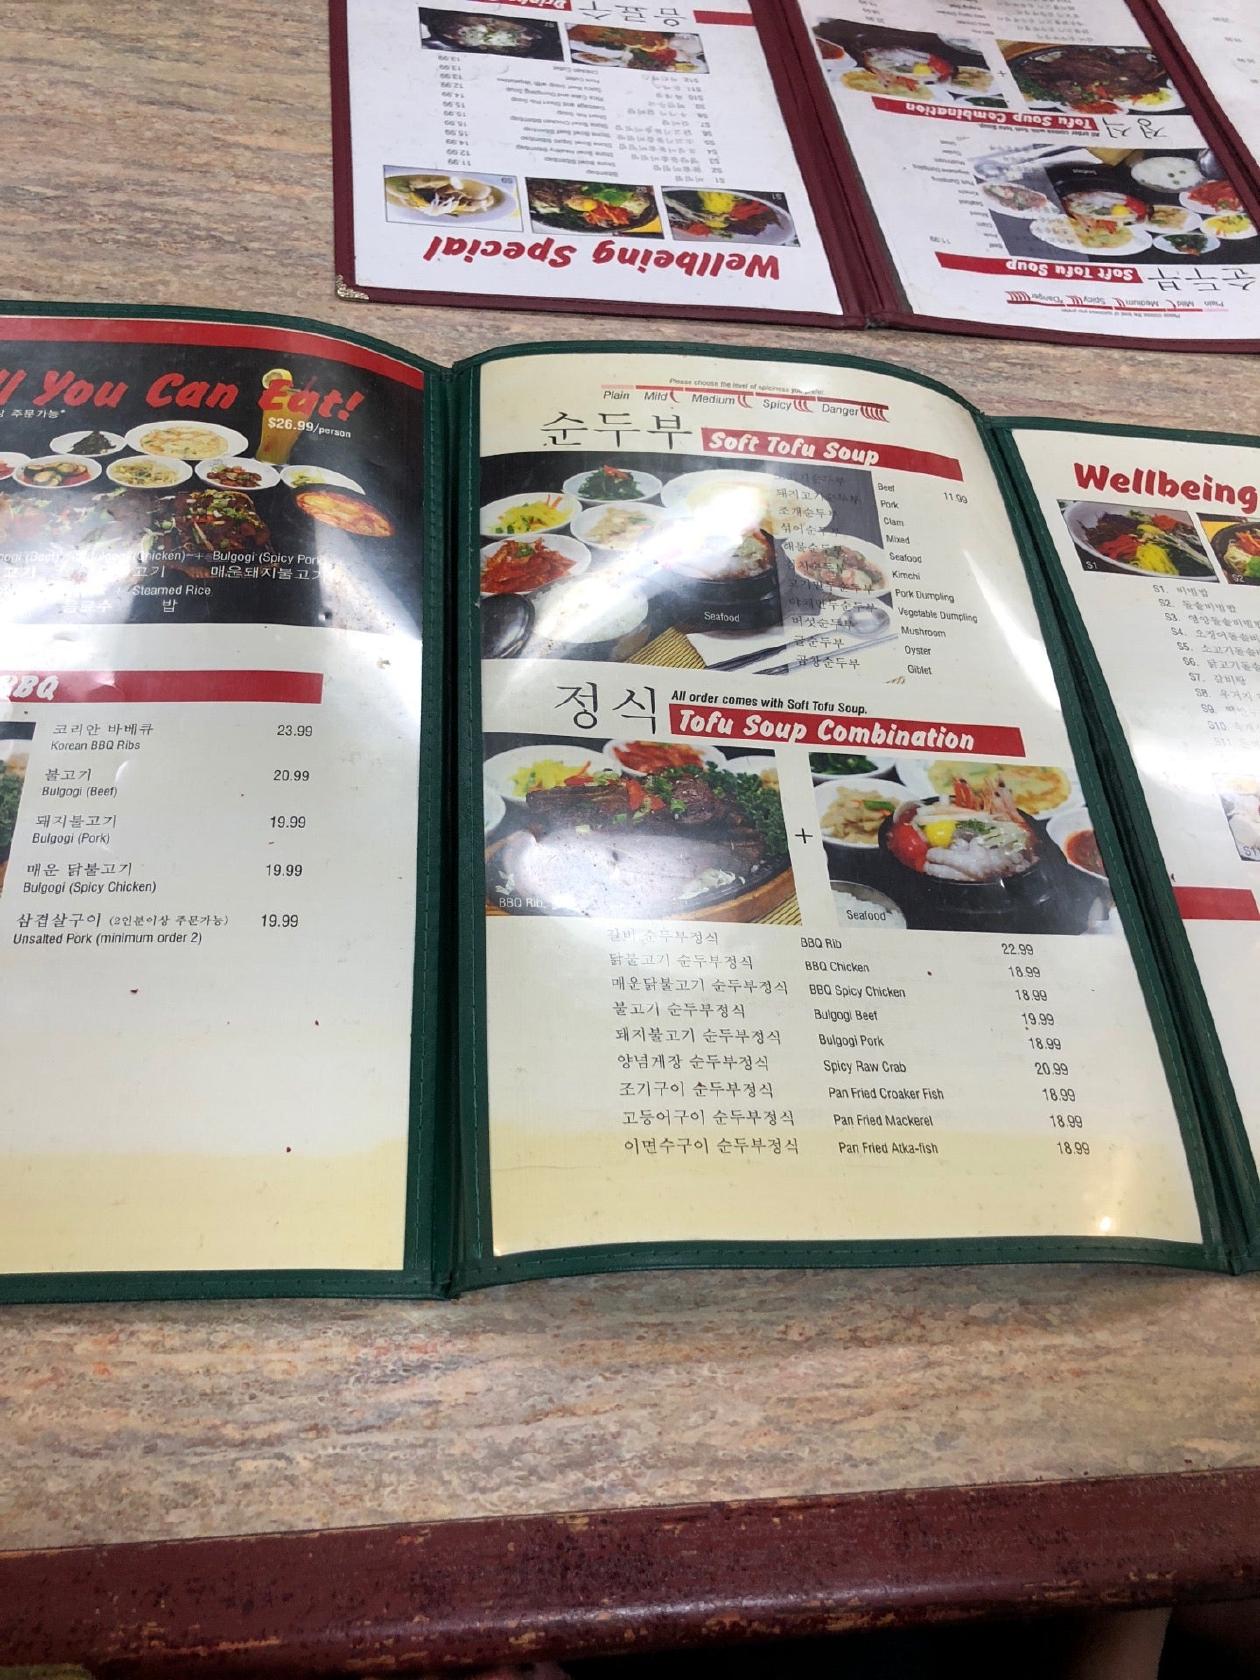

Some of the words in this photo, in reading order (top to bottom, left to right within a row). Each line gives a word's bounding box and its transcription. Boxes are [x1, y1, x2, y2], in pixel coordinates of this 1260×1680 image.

[905, 102, 1007, 124] Combination
[1014, 113, 1052, 127] Soup
[1058, 116, 1092, 129] Tofu
[423, 235, 577, 268] Special
[592, 240, 781, 280] Wellbeing
[1005, 260, 1048, 275] Soup
[1055, 266, 1093, 279] Tofu
[1098, 269, 1133, 281] Soft
[33, 370, 128, 408] You
[146, 373, 239, 409] Can
[258, 379, 365, 421] Eat!
[603, 390, 629, 400] Plain
[644, 391, 667, 401] Mild
[692, 393, 735, 405] Medium
[763, 398, 792, 411] Spicy
[822, 403, 858, 417] Danger
[268, 417, 351, 438] $26.99/person
[541, 411, 693, 450] 순두부
[708, 431, 759, 453] Soft
[767, 435, 816, 459] Tofu
[823, 442, 879, 467] Soup
[878, 483, 895, 492] Beef
[1074, 462, 1258, 514] Wellbeing
[880, 500, 899, 509] Pork
[944, 492, 968, 504] 11.99
[883, 518, 904, 527] Clam
[886, 535, 910, 545] Mixed
[213, 551, 255, 563] Bulgogi
[259, 552, 293, 565] (Spicy
[889, 552, 922, 563] Seafood
[1086, 561, 1098, 570] S1
[892, 571, 920, 580] Kimchi
[1232, 574, 1244, 582] S2
[132, 585, 181, 596] Steamed
[186, 585, 211, 596] Rice
[895, 589, 914, 599] Pork
[916, 591, 955, 604] Dumpling
[162, 599, 178, 612] 밥
[704, 611, 740, 624] Seafood
[898, 607, 937, 619] Vegetable
[940, 611, 978, 624] Dumpling
[901, 626, 946, 638] Mushroom
[905, 645, 931, 657] Oyster
[907, 665, 932, 676] Giblet
[554, 681, 657, 735] 정식
[672, 690, 686, 702] All
[689, 692, 719, 705] order
[722, 697, 758, 708] comes
[761, 696, 784, 709] with
[787, 698, 810, 711] Soft
[812, 700, 835, 712] Tofu
[838, 702, 867, 715] Soup.
[53, 723, 101, 736] 코리안
[108, 723, 154, 736] 바베큐
[277, 724, 313, 738] 23.99
[679, 709, 734, 736] Tofu
[744, 716, 807, 744] Soup
[818, 718, 974, 750] Combination
[51, 741, 87, 751] Korean
[91, 741, 114, 751] BBQ
[117, 741, 141, 751] Ribs
[45, 768, 92, 782] 불고기
[273, 770, 310, 783] 20.99
[42, 786, 82, 798] Bulgogi
[86, 786, 118, 798] (Beef)
[35, 814, 117, 829] 돼지불고기
[270, 816, 306, 829] 19.99
[32, 832, 74, 845] Bulgogi
[77, 832, 110, 845] (Pork)
[27, 862, 60, 877] 매운
[67, 862, 132, 877] 닭불고기
[266, 864, 303, 877] 19.99
[23, 881, 65, 894] Bulgogi
[69, 881, 104, 894] (Spicy
[108, 881, 156, 893] Chicken)
[17, 912, 101, 928] 삼겹살구이
[175, 914, 228, 927] 주문가능)
[261, 914, 299, 928] 19.99
[846, 909, 886, 922] Seafood
[13, 932, 62, 945] Unsalted
[66, 933, 92, 944] Pork
[96, 933, 153, 946] (minimum
[157, 932, 187, 944] order
[190, 932, 202, 946] 2)
[800, 937, 822, 948] BBQ
[825, 938, 842, 949] Rib
[1001, 943, 1034, 955] 22.99
[677, 954, 753, 970] 순두부정식
[805, 961, 827, 971] BBQ
[830, 962, 870, 972] Chicken
[1008, 966, 1040, 977] 18.99
[612, 976, 704, 992] 매운닭불고기
[712, 979, 788, 994] 순두부정식
[809, 984, 832, 995] BBQ
[835, 985, 862, 998] Spicy
[866, 986, 906, 997] Chicken
[1015, 989, 1047, 1001] 18.99
[613, 1001, 660, 1016] 불고기
[667, 1002, 745, 1018] 순두부정식
[814, 1009, 852, 1022] Bulgogi
[855, 1010, 878, 1021] Beef
[1022, 1013, 1054, 1025] 19.99
[616, 1027, 695, 1042] 돼지불고기
[703, 1028, 781, 1045] 순두부정식
[819, 1034, 858, 1047] Bulgogi
[860, 1035, 885, 1047] Pork
[1028, 1038, 1061, 1050] 18.99
[618, 1053, 683, 1069] 양념게장
[689, 1054, 769, 1071] 순두부정식
[824, 1060, 852, 1074] Spicy
[856, 1060, 879, 1072] Raw
[882, 1061, 907, 1073] Crab
[1034, 1062, 1068, 1075] 20.99
[620, 1081, 684, 1096] 조기구이
[692, 1081, 773, 1098] 순두부정식
[829, 1087, 849, 1098] Pan
[851, 1088, 877, 1099] Fried
[879, 1088, 919, 1099] Croaker
[922, 1088, 944, 1100] Fish
[1042, 1088, 1075, 1101] 18.99
[623, 1109, 705, 1126] 고등어구이
[713, 1110, 794, 1126] 순두부정식
[833, 1114, 853, 1125] Pan
[857, 1114, 882, 1126] Fried
[885, 1115, 933, 1126] Mackerel
[1049, 1115, 1082, 1128] 18.99
[624, 1138, 708, 1155] 이면수구이
[717, 1137, 799, 1155] 순두부정식
[839, 1142, 859, 1153] Pan
[862, 1142, 888, 1154] Fried
[891, 1142, 938, 1154] Atka-fish
[1057, 1142, 1090, 1155] 18.99
